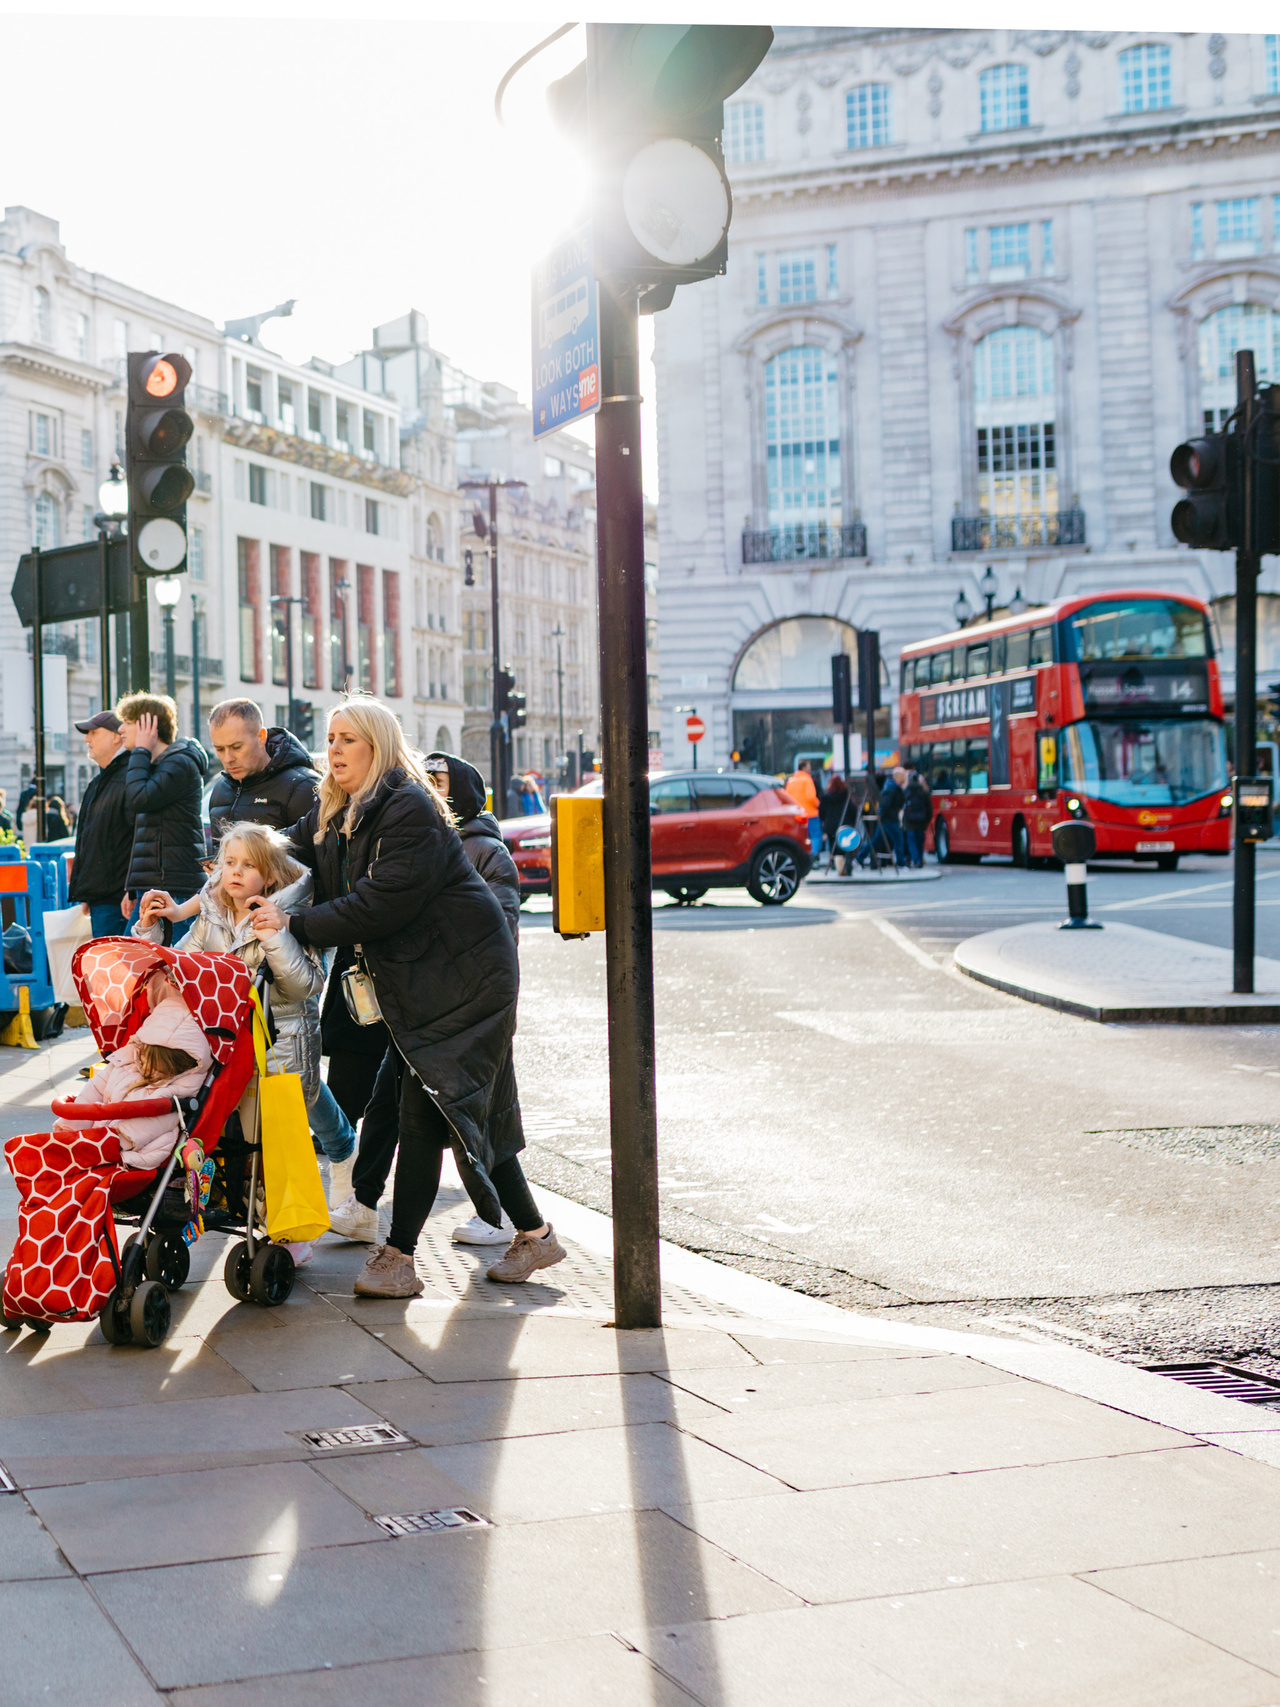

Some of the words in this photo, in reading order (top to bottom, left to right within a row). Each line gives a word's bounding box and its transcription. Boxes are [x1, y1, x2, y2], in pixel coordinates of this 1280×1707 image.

[536, 260, 558, 292] BUS
[560, 238, 589, 276] LANE
[535, 356, 562, 391] LOOK
[565, 338, 595, 375] BOTH
[550, 383, 579, 419] WAYS
[937, 688, 987, 719] SCREAM
